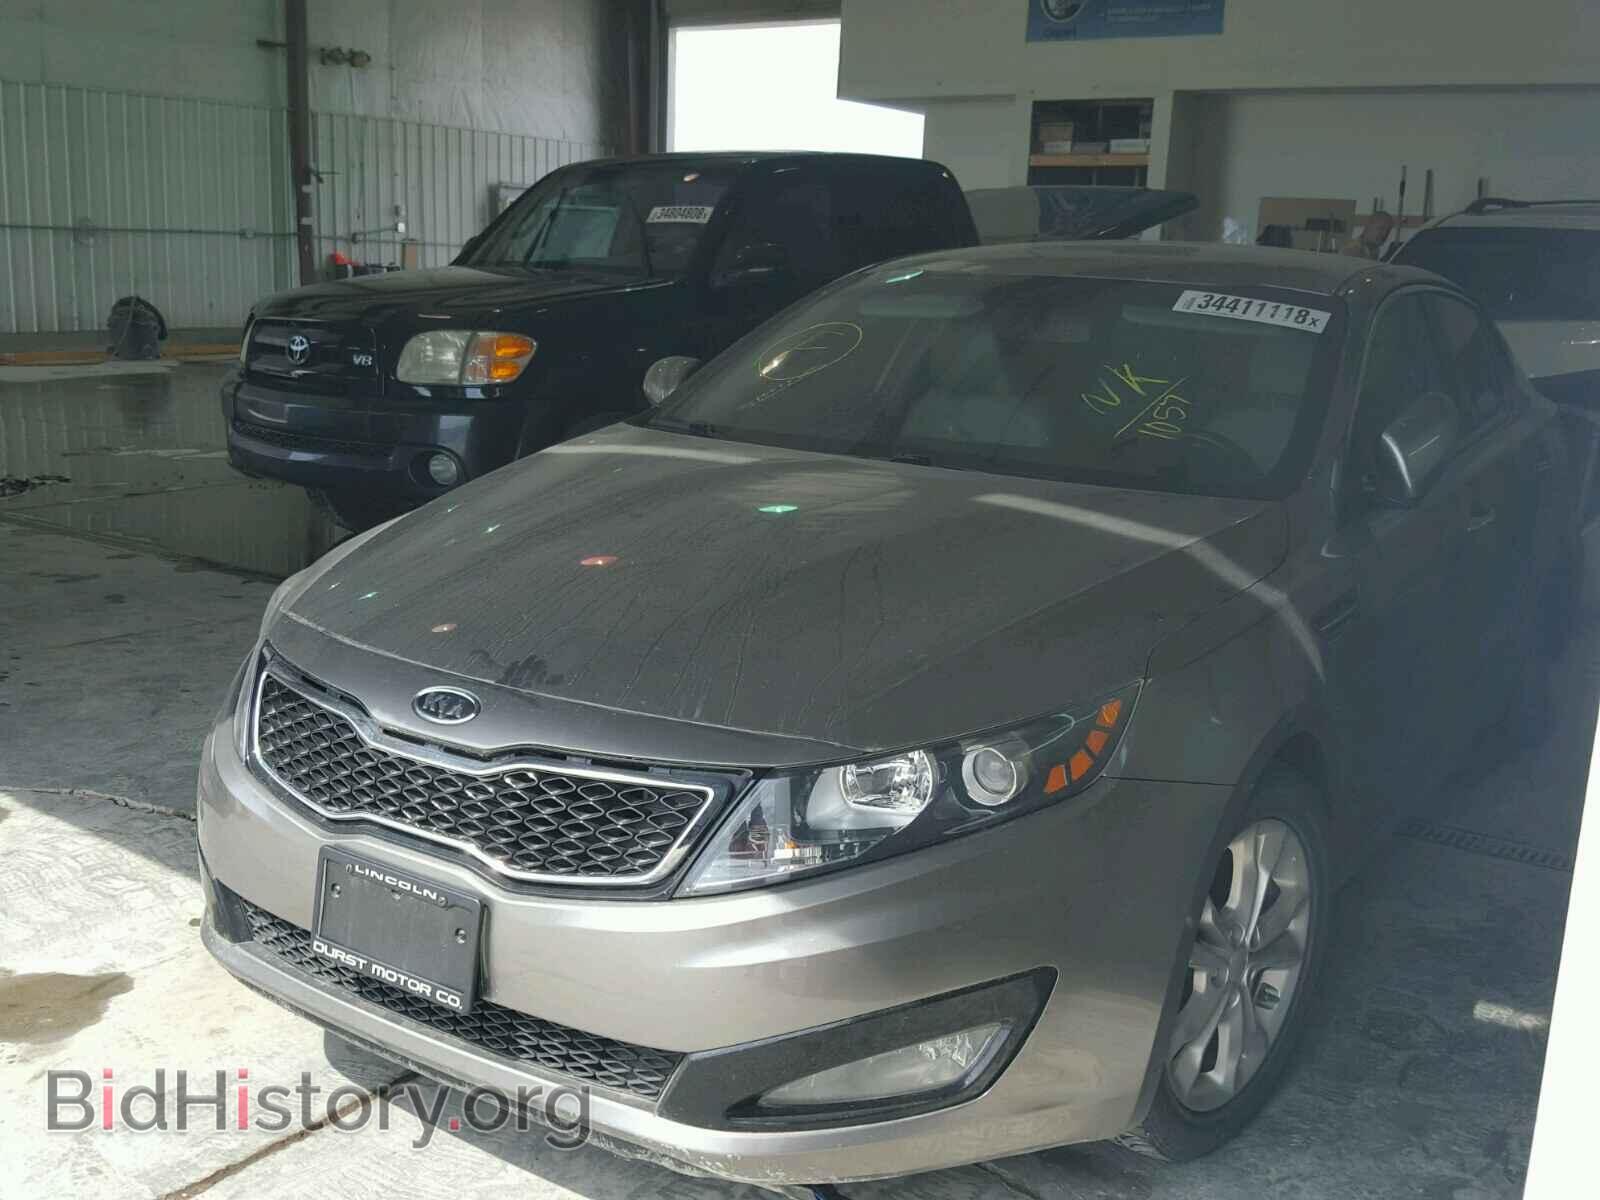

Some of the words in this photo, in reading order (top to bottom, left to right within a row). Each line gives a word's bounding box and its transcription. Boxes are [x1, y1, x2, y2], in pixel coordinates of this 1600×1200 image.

[355, 864, 437, 900] LINCOLN
[313, 940, 367, 970] DURST
[371, 964, 432, 997] MOTOR
